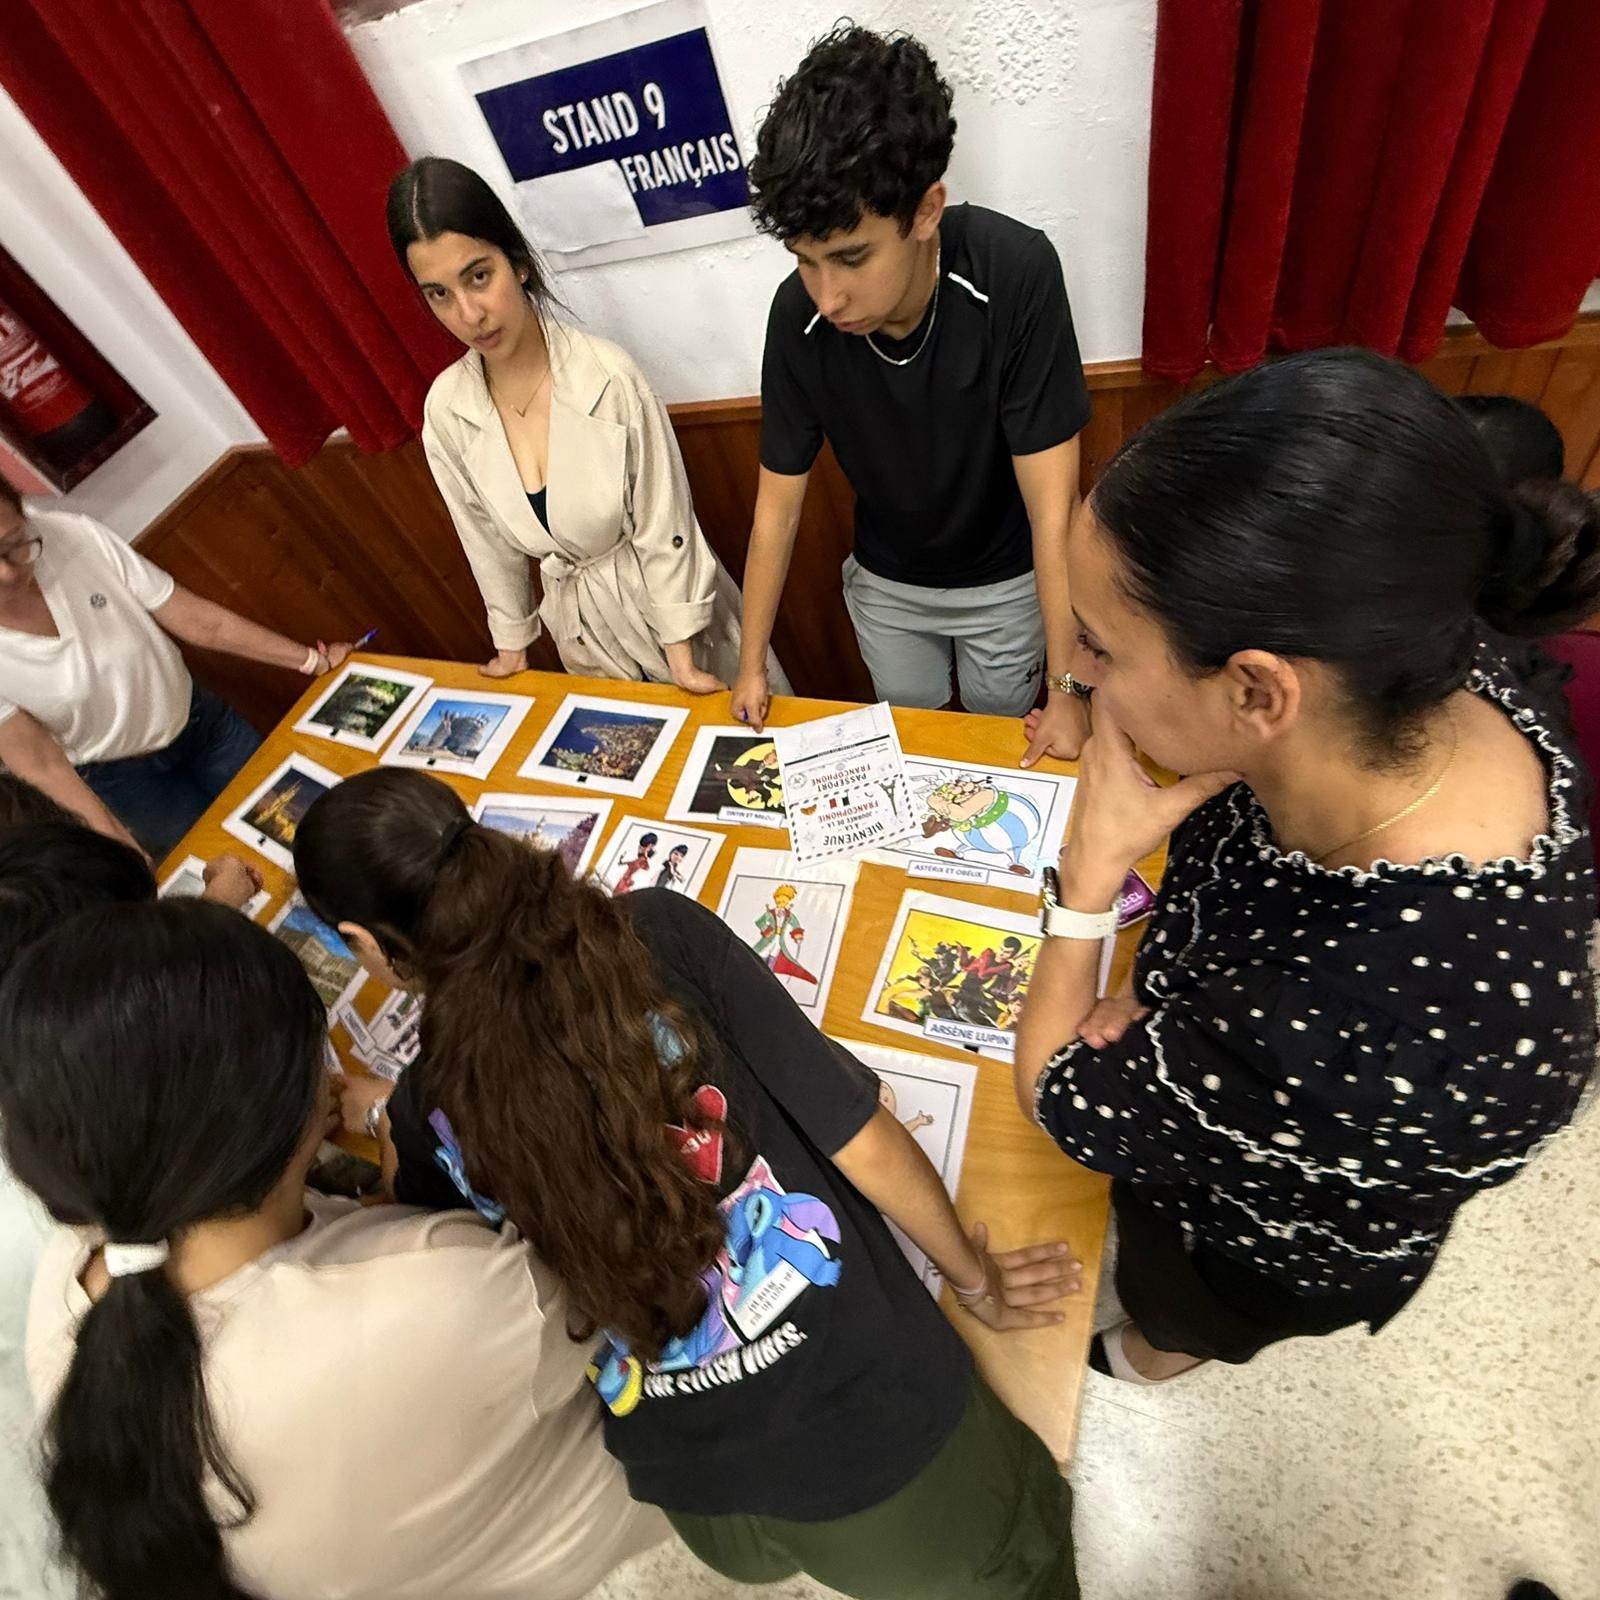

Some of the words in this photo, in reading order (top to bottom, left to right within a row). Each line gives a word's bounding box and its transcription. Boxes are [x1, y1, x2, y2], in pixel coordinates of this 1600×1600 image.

[542, 91, 639, 154] STAND
[643, 82, 666, 130] 9
[620, 133, 740, 193] FRANÇAIS
[812, 764, 871, 785] FRANCOPHONE
[817, 774, 867, 792] PASSEPORT
[819, 801, 879, 822] FRANCOPHONIE
[824, 822, 884, 846] BIENVENUE
[945, 867, 955, 875] ET
[930, 1023, 974, 1040] ARSÈNE
[975, 1031, 1011, 1046] LUPIN
